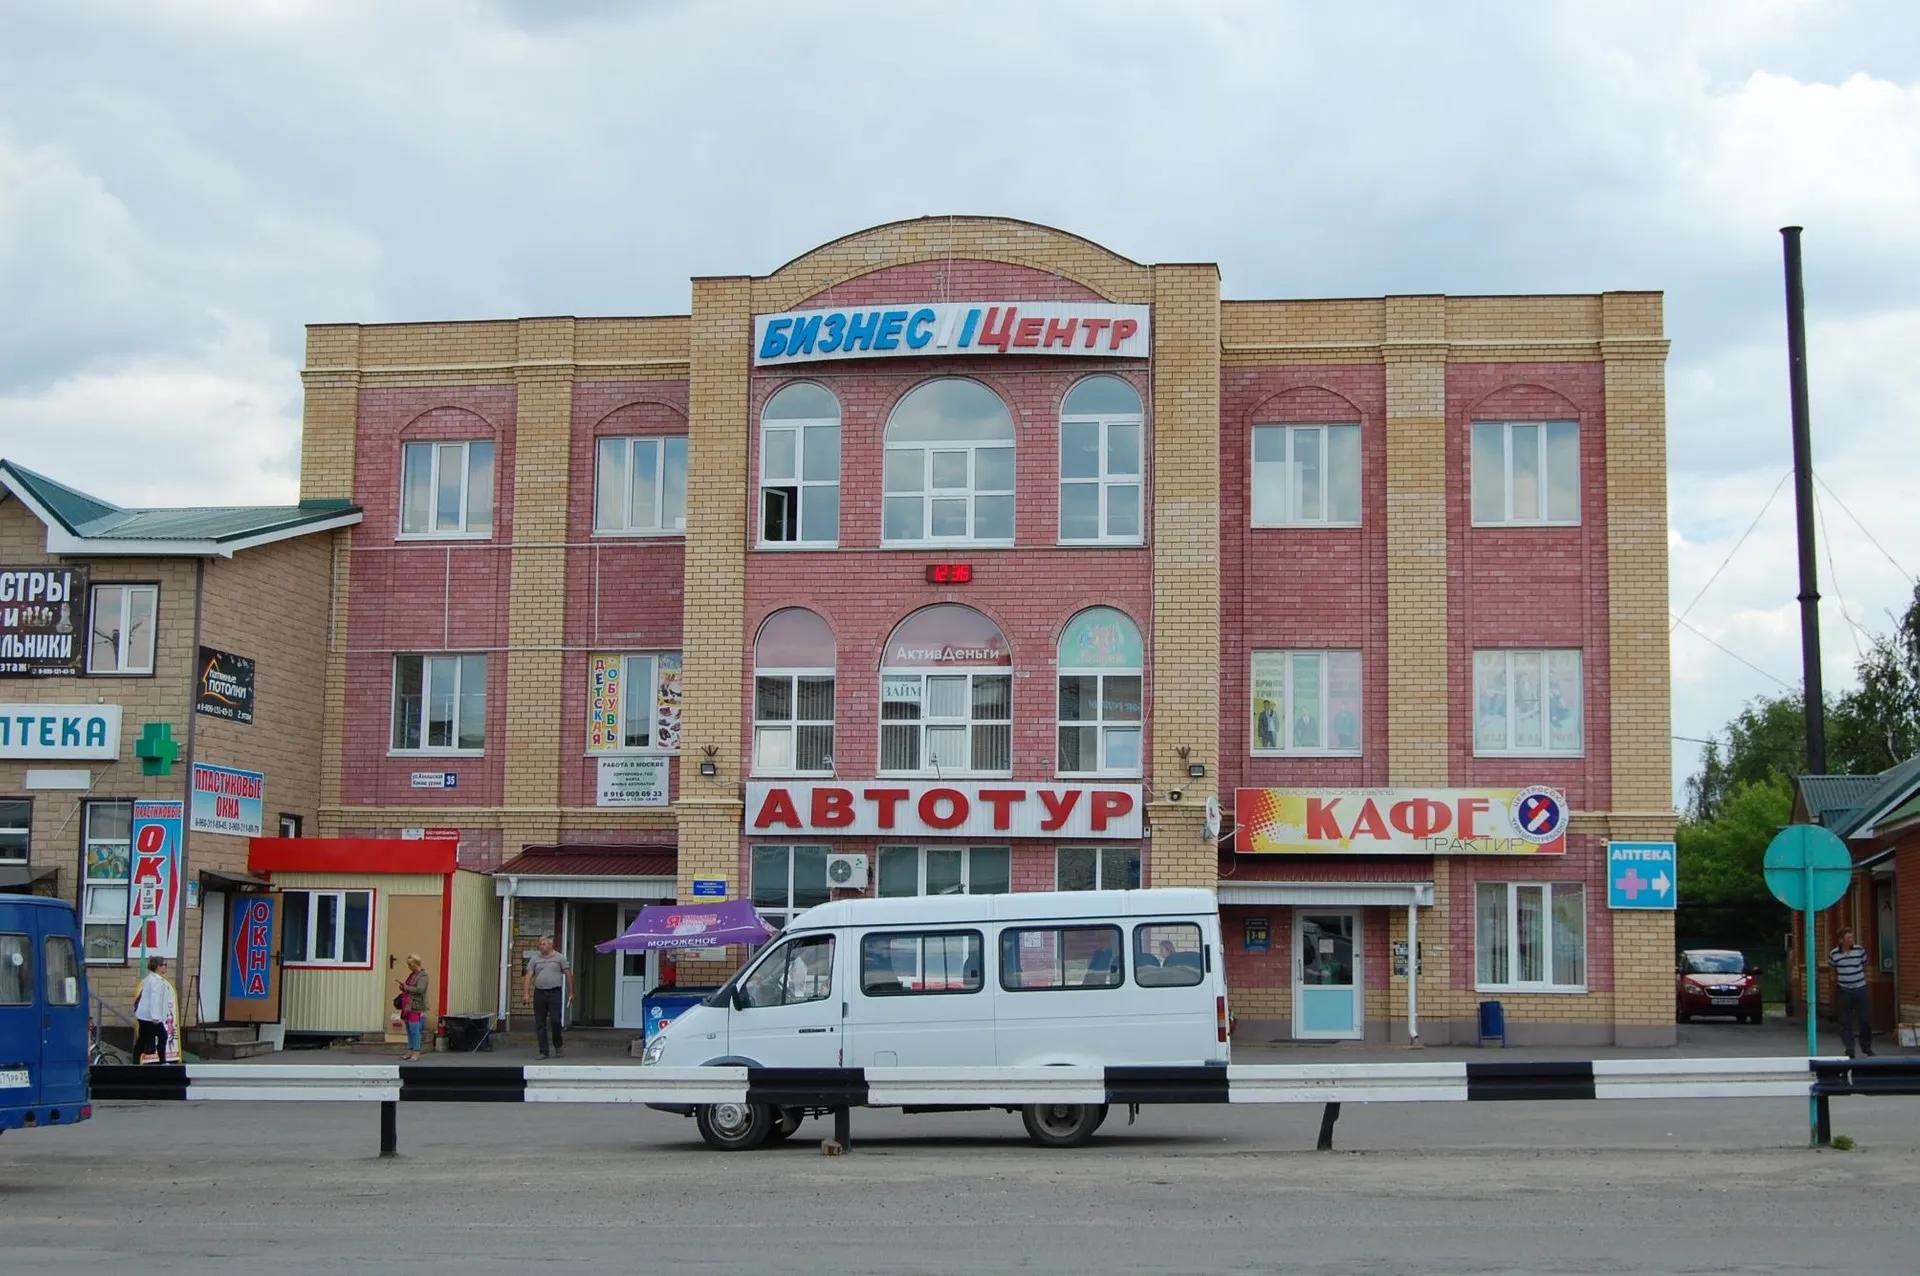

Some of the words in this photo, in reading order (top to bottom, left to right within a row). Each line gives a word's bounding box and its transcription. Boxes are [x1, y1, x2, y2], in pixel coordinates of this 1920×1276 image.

[759, 308, 936, 358] БИЗНЕС
[978, 307, 1138, 352] ЦЕНТР
[0, 634, 72, 658] ЛЬНИКИ
[896, 647, 1000, 662] АктивДеньги
[208, 679, 247, 699] ПОТОЛКИ
[884, 683, 922, 698] ЗАЙМ
[592, 659, 606, 745] ДЕТСКАЯ
[606, 668, 619, 742] ОБУВЬ
[195, 768, 262, 799] ПЛАСТИКОВЫЕ
[446, 775, 456, 785] 35
[216, 796, 240, 820] ОКНА
[754, 787, 1133, 831] АВТОТУР
[1306, 797, 1490, 841] КАФЕ
[1418, 837, 1526, 851] ТРАКТИР
[1611, 848, 1672, 861] АПТЕКА
[248, 901, 270, 995] ОКНА
[647, 937, 718, 947] МОРОЖЕНОЕ
